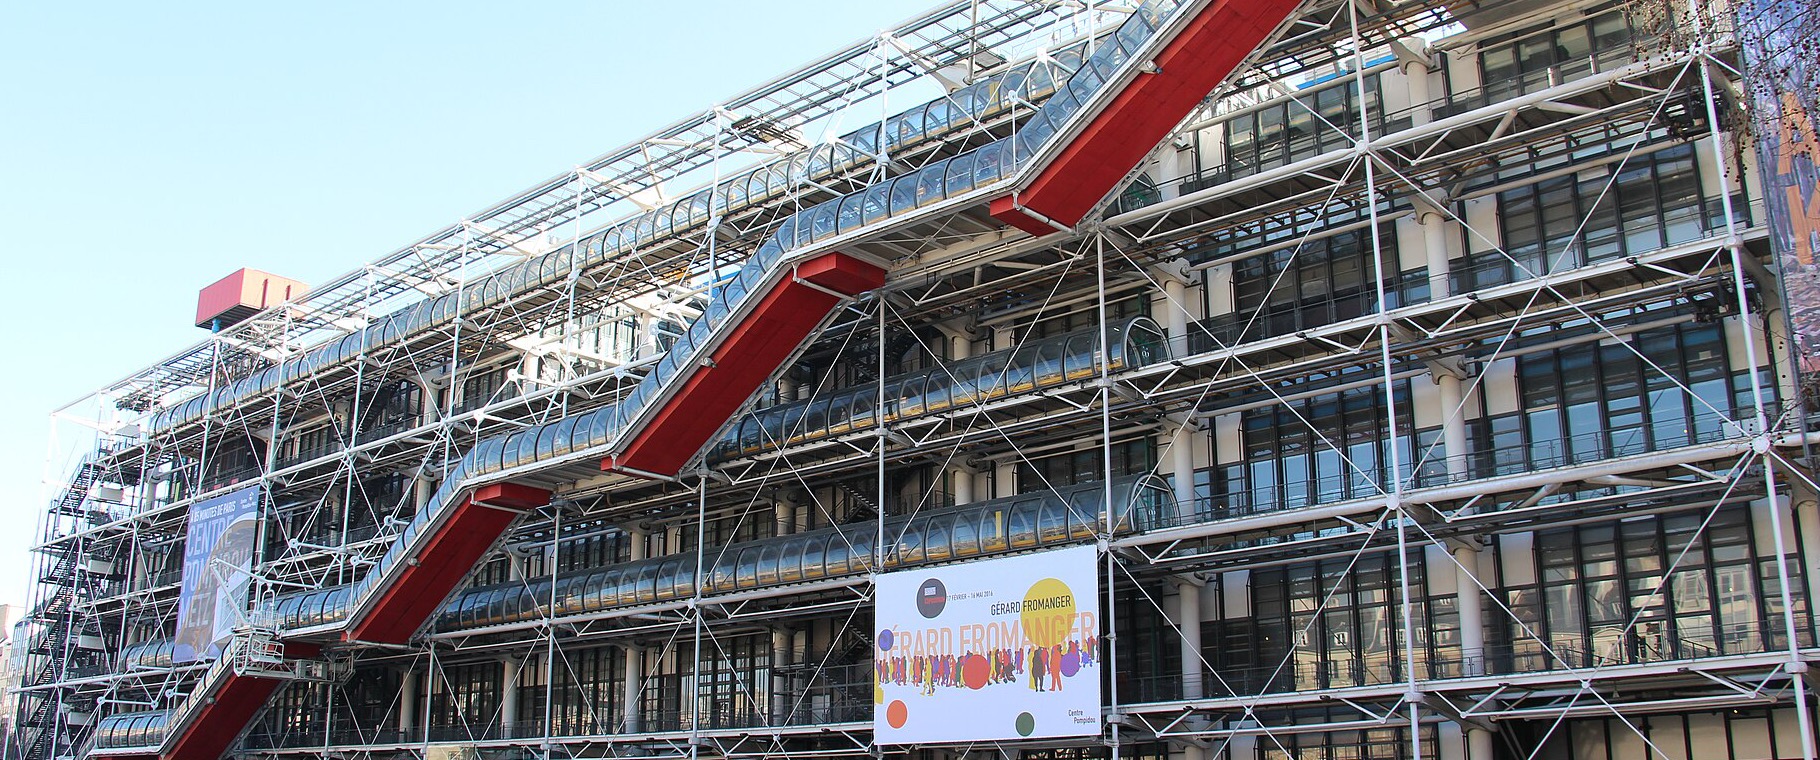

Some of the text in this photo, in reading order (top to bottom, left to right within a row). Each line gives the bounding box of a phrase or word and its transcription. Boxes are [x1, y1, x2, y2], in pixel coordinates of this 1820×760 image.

[217, 503, 223, 516] DE
[223, 500, 236, 514] PARIS
[187, 515, 234, 557] CENTRE
[976, 591, 984, 599] MAI
[984, 590, 994, 598] 2016
[178, 592, 211, 629] METZ
[990, 595, 1071, 616] GÉRARD FROMANGER
[959, 611, 1096, 658] FROMANGER
[1068, 709, 1084, 717] Centre
[1073, 716, 1096, 725] Pompidou
